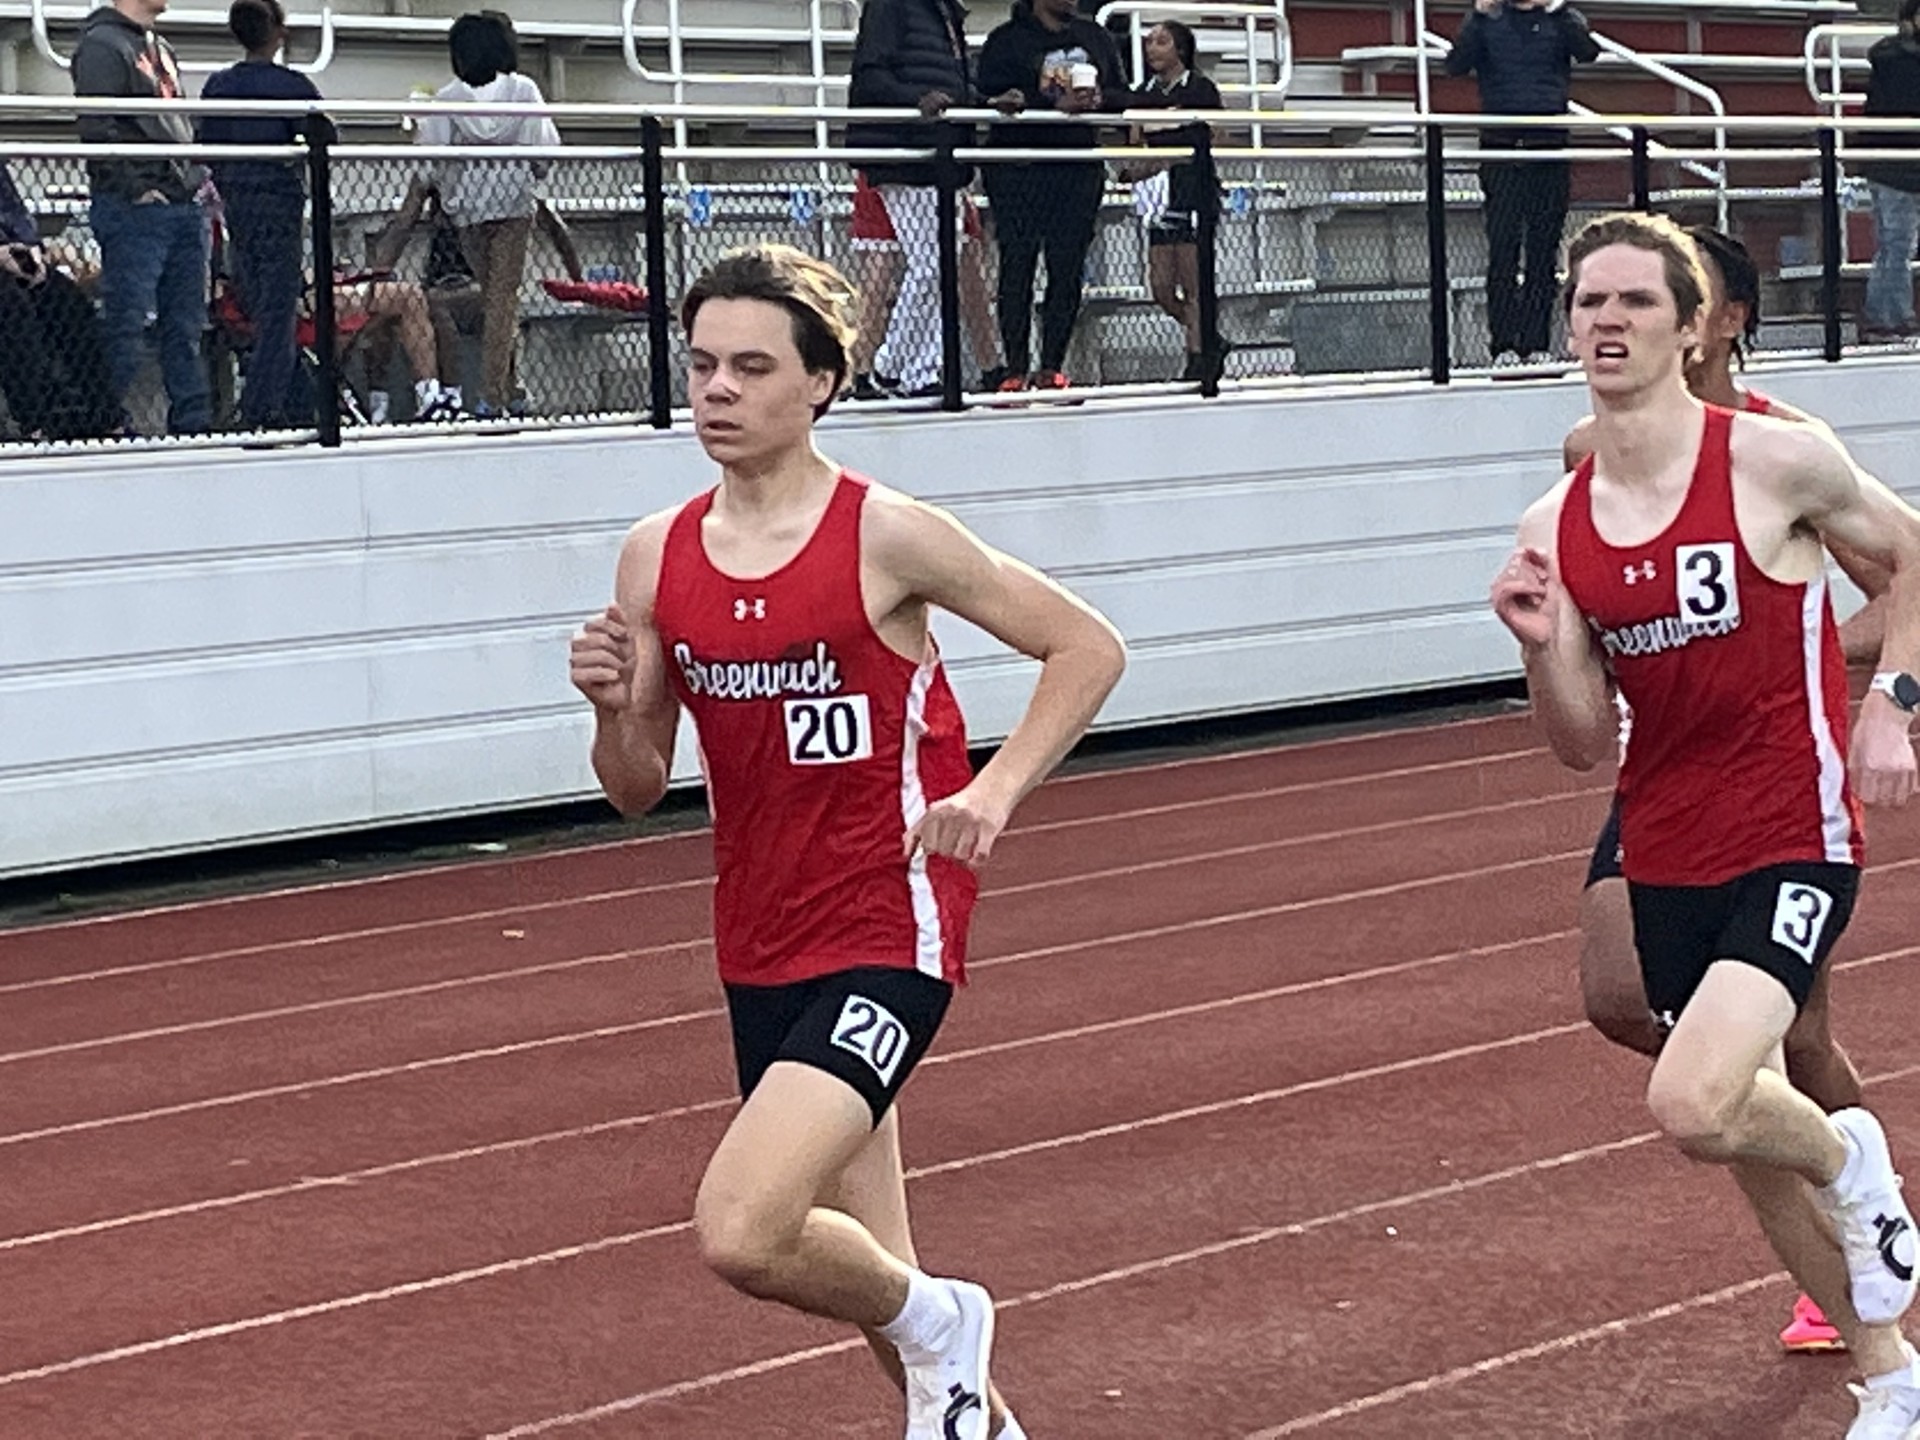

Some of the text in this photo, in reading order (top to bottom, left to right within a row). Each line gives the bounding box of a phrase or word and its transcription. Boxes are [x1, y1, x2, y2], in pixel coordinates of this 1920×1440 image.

[1685, 550, 1727, 616] 3
[674, 641, 841, 699] Greenwich
[790, 702, 858, 760] 20
[1783, 888, 1821, 948] 3
[838, 1002, 901, 1071] 20
